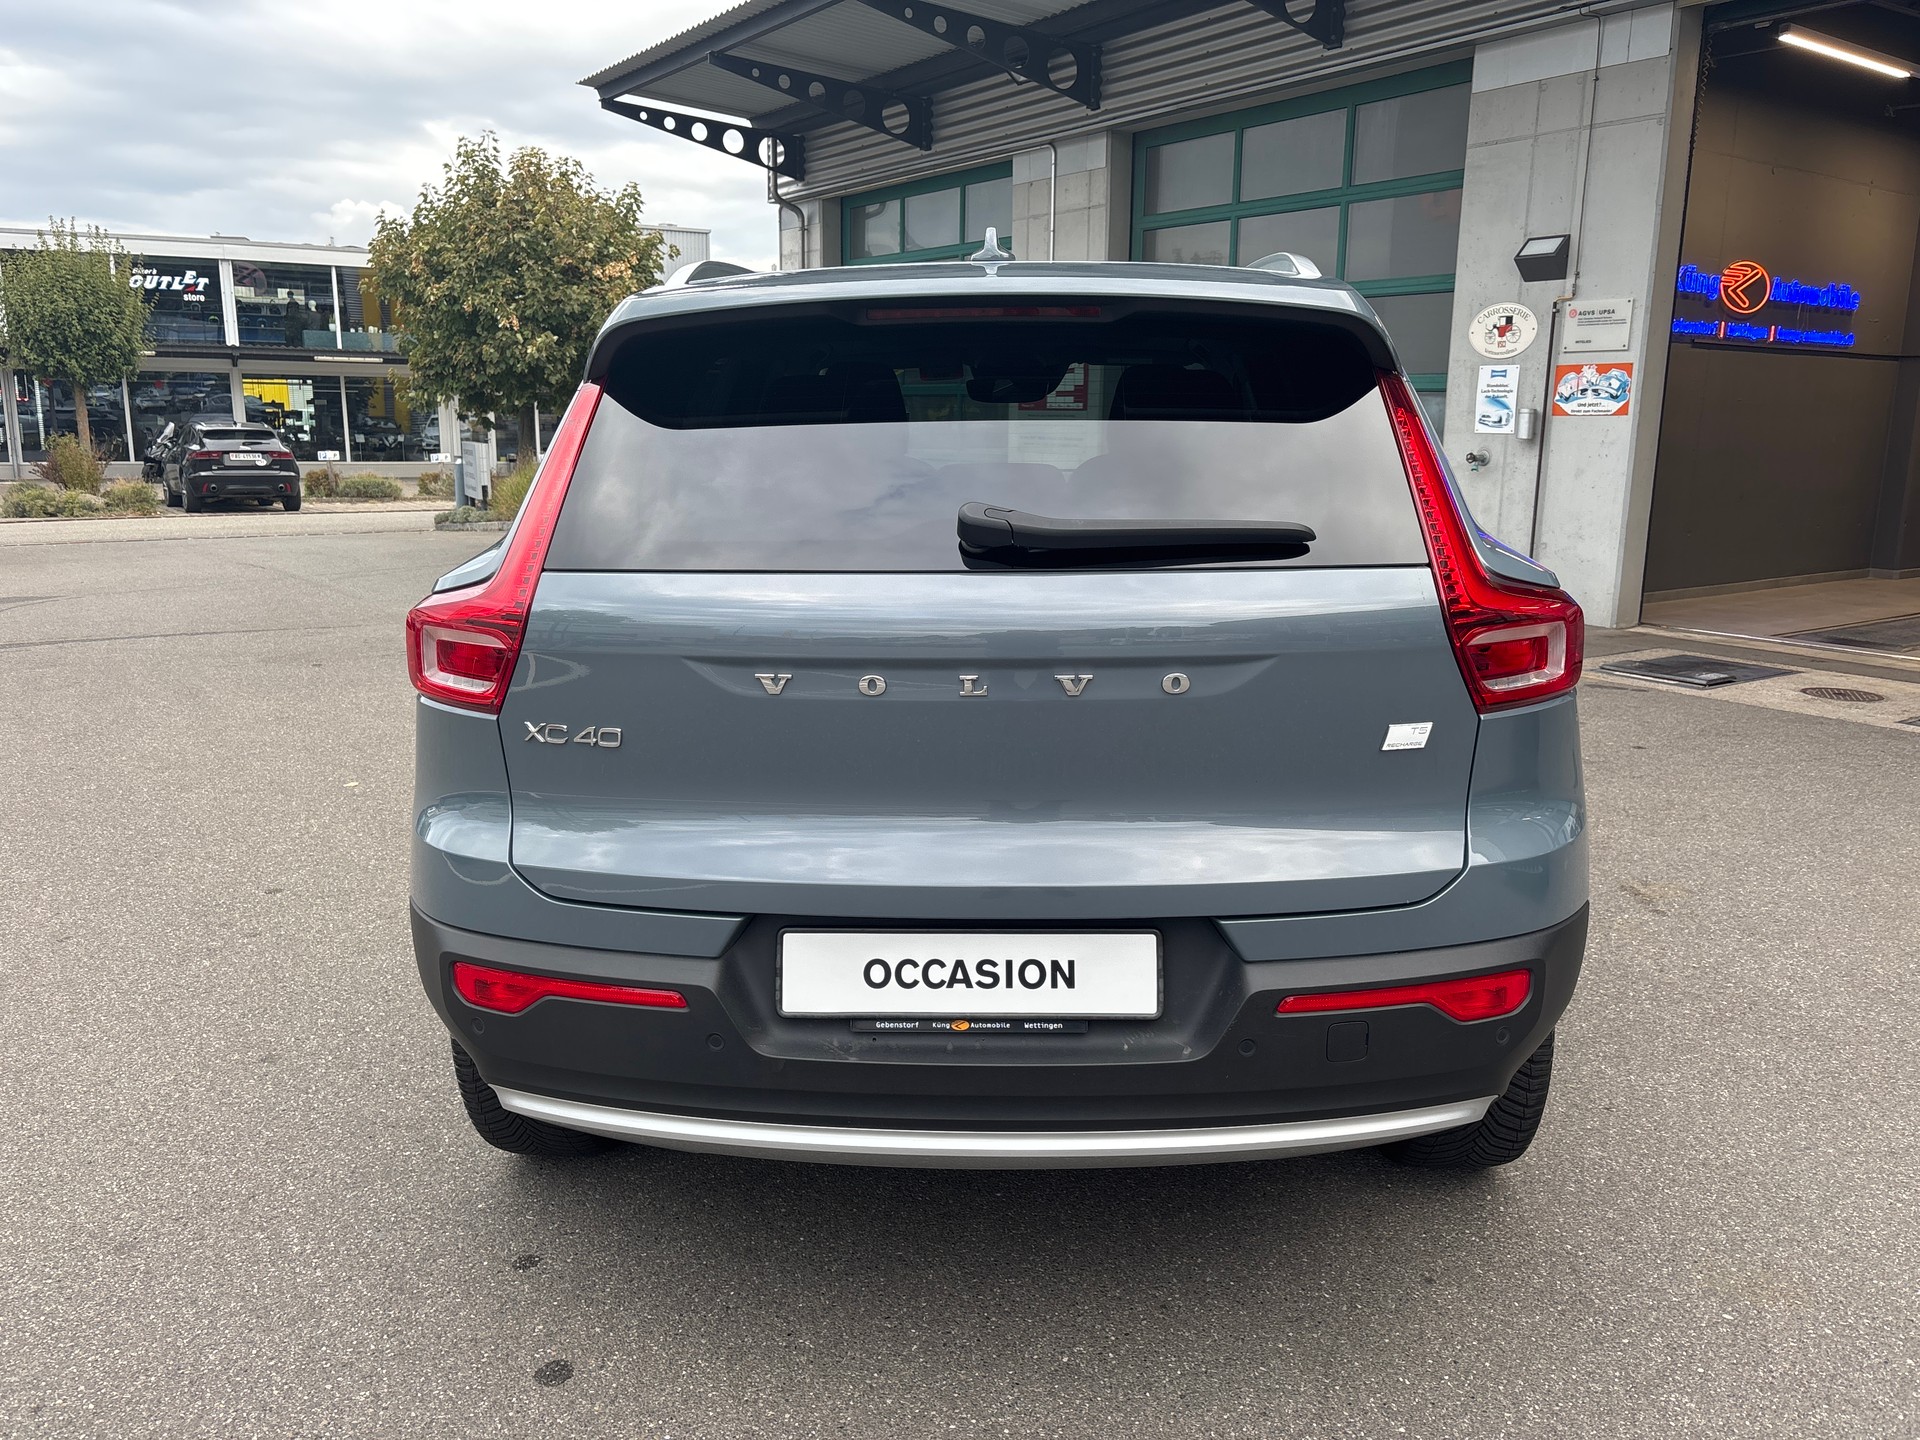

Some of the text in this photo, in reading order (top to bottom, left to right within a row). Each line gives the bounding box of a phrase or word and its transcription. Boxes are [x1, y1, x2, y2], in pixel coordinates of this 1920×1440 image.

[128, 270, 209, 291] OUTLET
[183, 293, 205, 302] store
[1770, 276, 1860, 311] Automobile
[1477, 306, 1531, 324] CARROSSERIE
[754, 673, 1190, 696] VOLVO
[1411, 726, 1429, 735] T5
[863, 958, 1076, 989] OCCASION
[876, 1021, 1063, 1030] Gebenstorf Küng Automobile Wettingen
